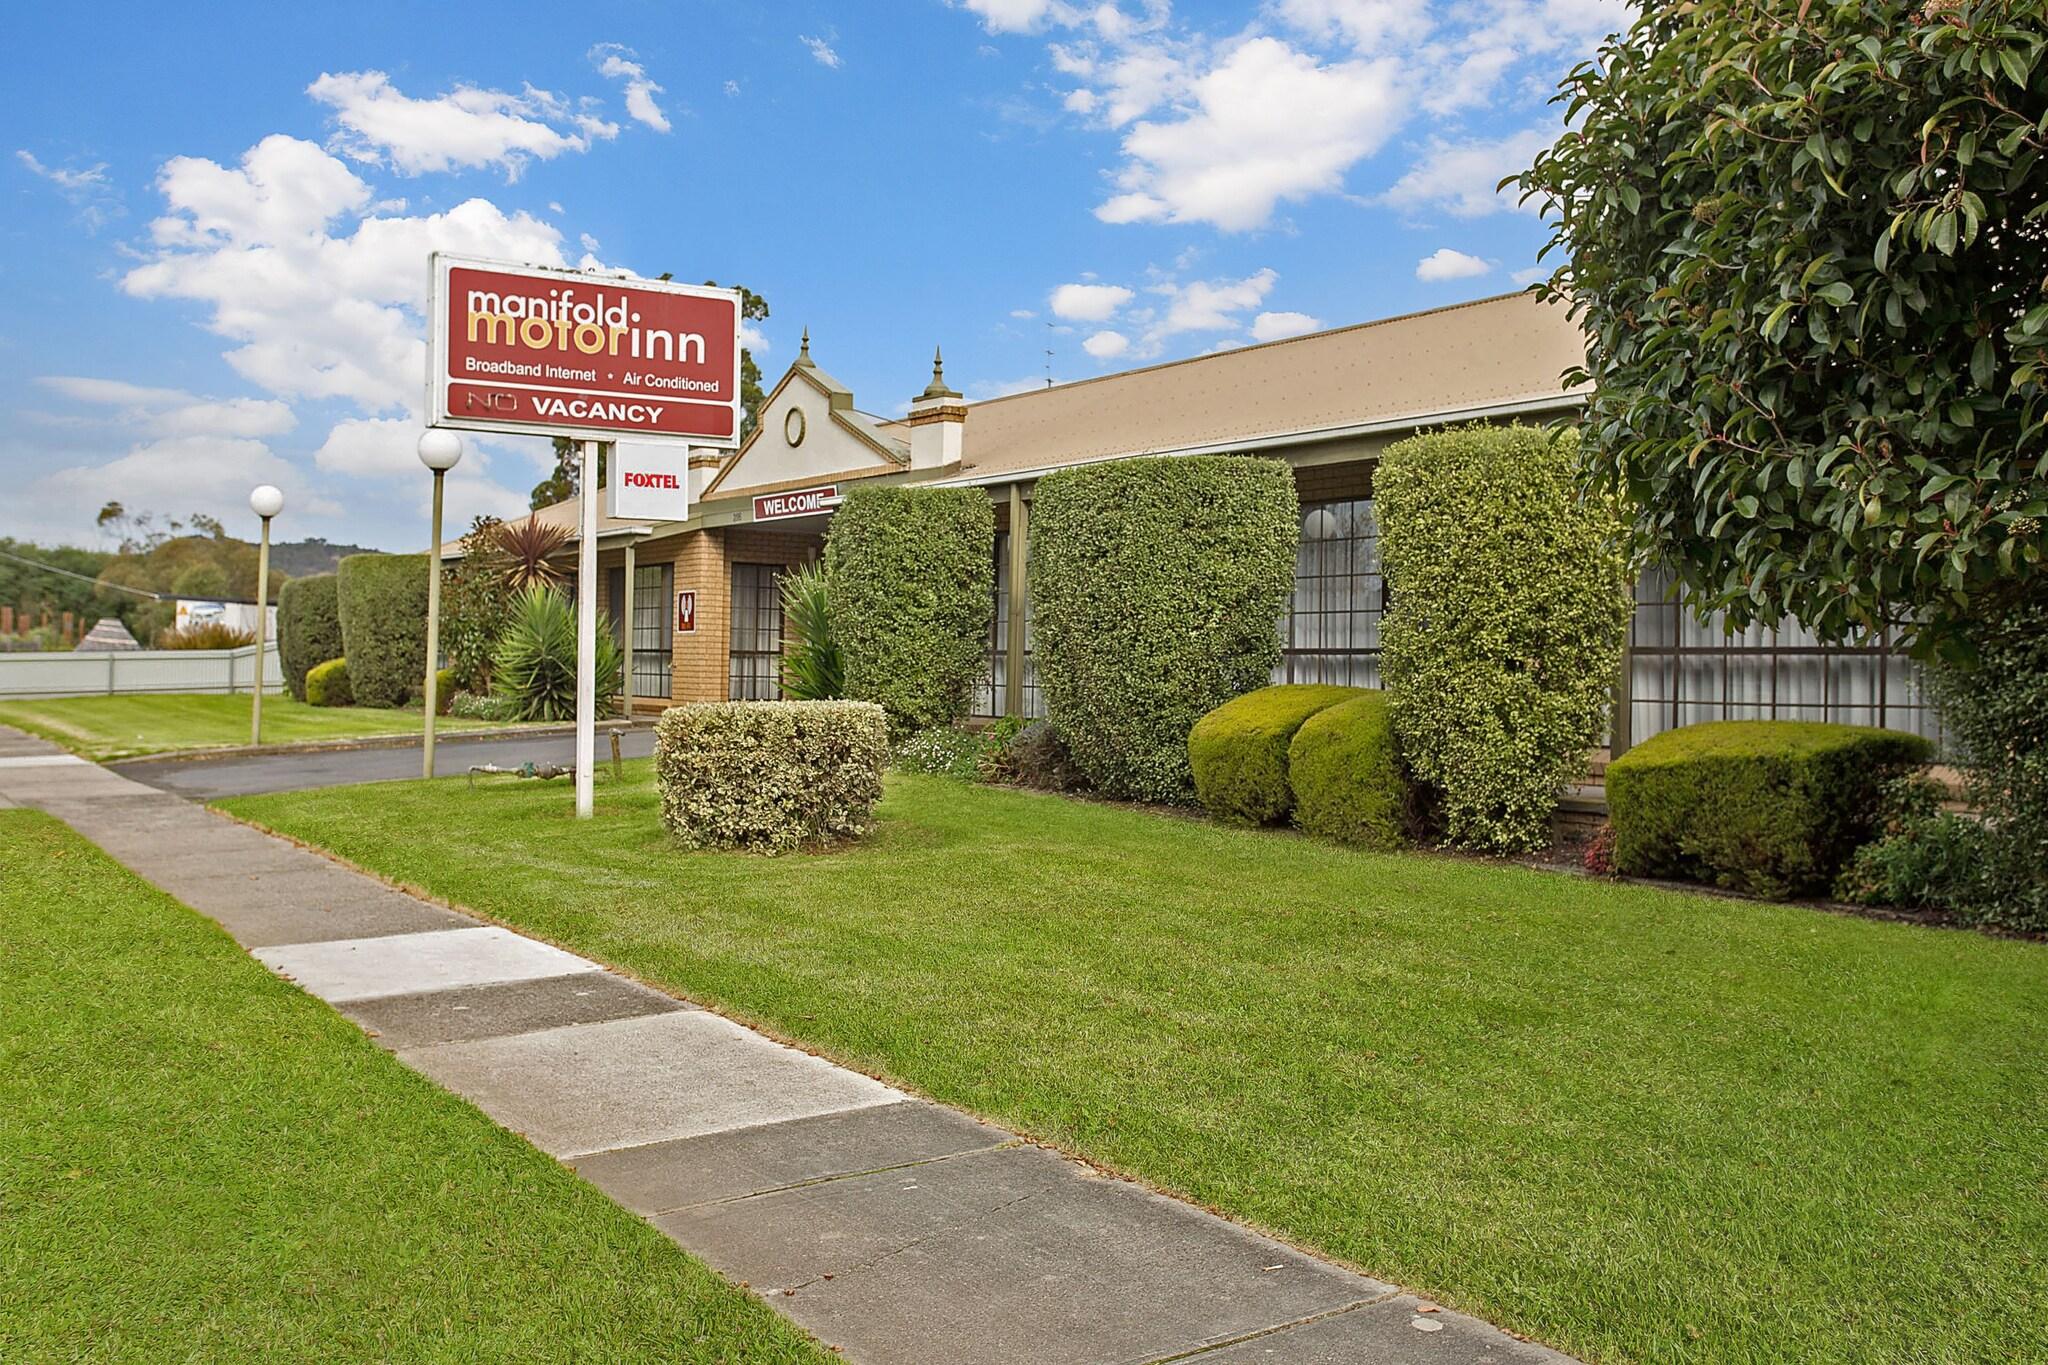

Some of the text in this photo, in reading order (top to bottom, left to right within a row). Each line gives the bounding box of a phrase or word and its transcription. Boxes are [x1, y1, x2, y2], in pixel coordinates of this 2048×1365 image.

[468, 289, 628, 328] manifold
[467, 310, 629, 356] motor
[465, 356, 719, 393] Broadband Internet Air Conditioned
[466, 391, 664, 424] NO VACANCY
[624, 472, 680, 489] FOXTEL
